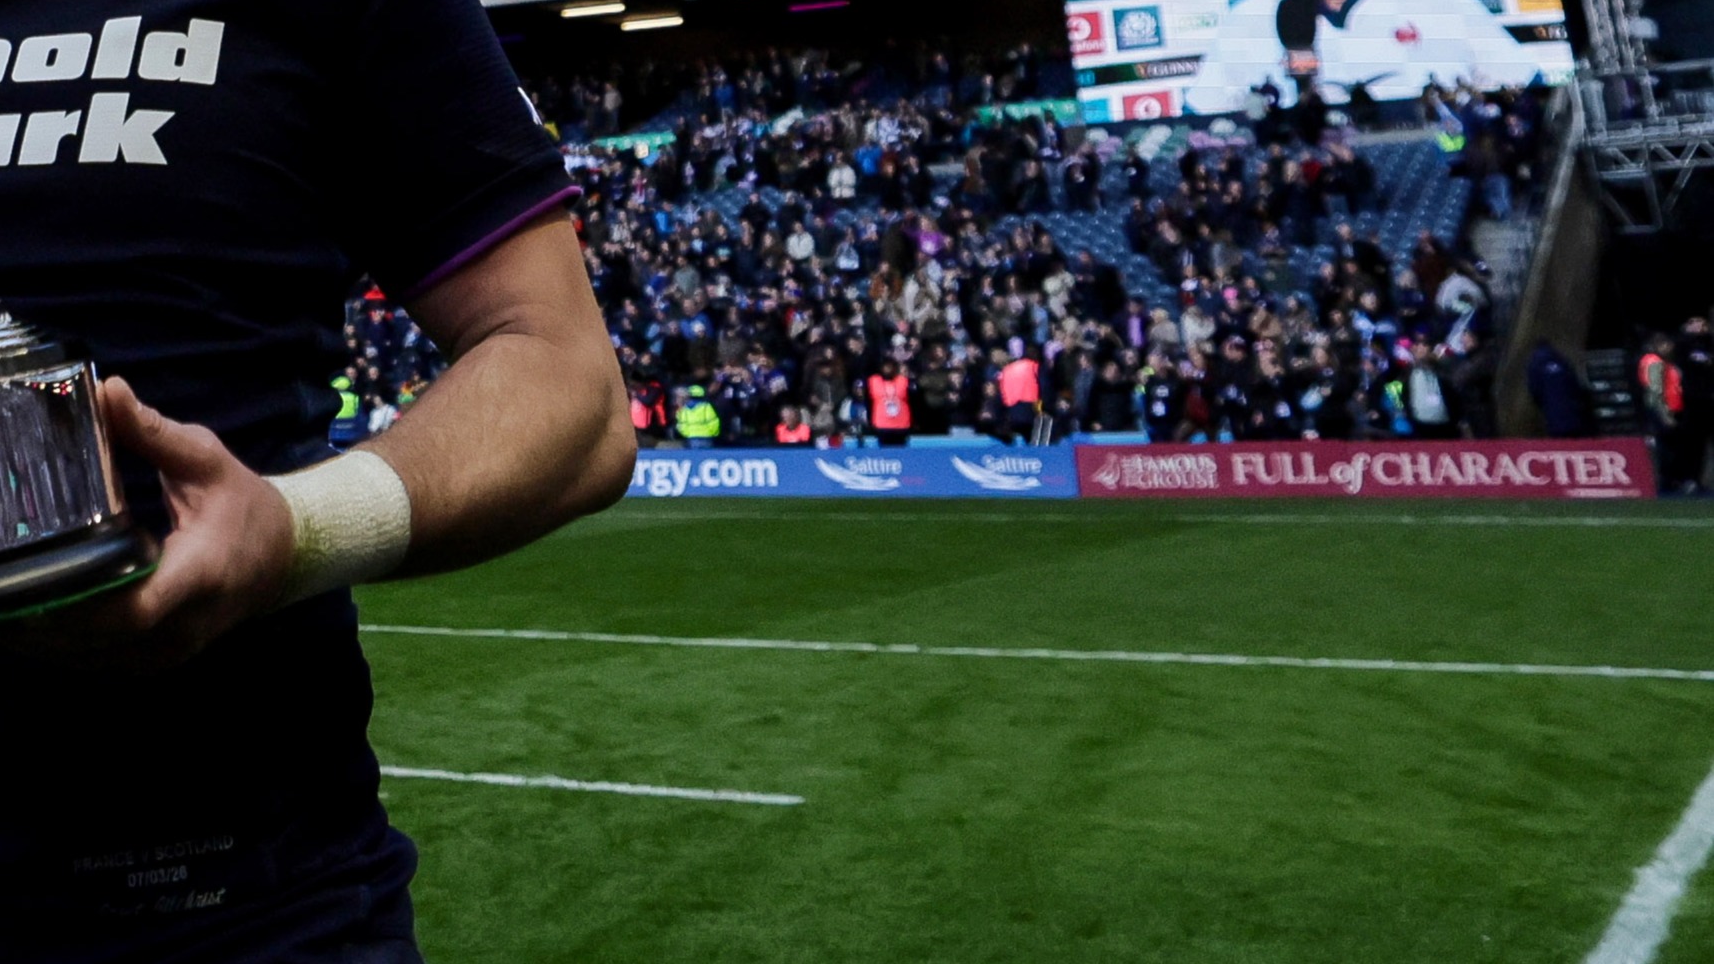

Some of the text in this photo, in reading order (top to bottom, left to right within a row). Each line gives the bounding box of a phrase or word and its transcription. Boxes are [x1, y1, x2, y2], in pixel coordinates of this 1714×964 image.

[629, 458, 779, 498] rgy.com
[843, 455, 903, 476] Saltire
[981, 453, 1043, 476] Saltire
[1133, 453, 1218, 473] FAMOUS
[1231, 449, 1632, 495] FULL of CHARACTER
[72, 849, 135, 875] FRANCE
[153, 834, 235, 862] SCOTLAND
